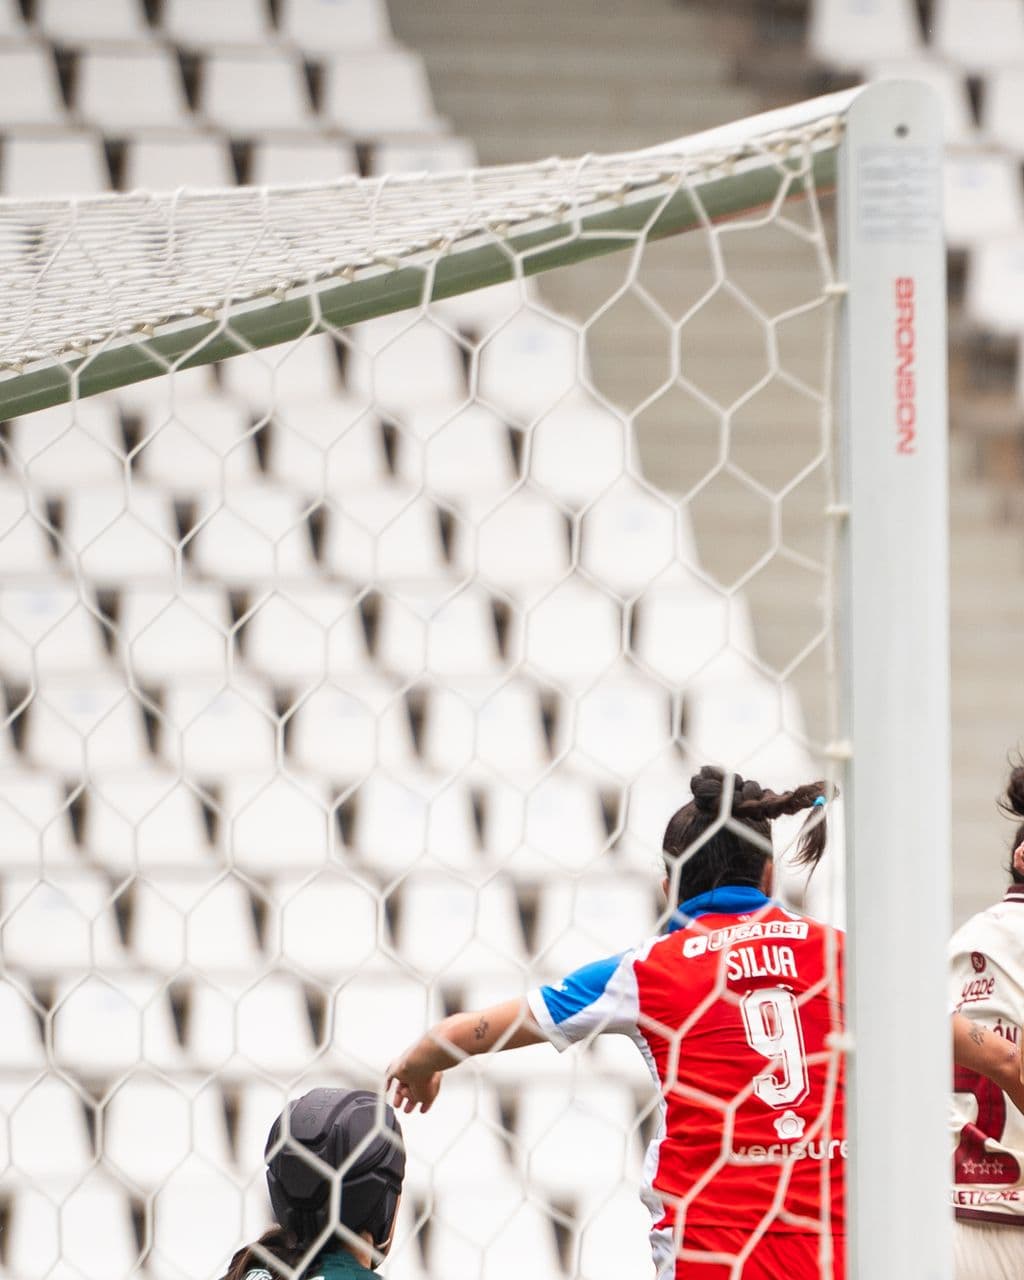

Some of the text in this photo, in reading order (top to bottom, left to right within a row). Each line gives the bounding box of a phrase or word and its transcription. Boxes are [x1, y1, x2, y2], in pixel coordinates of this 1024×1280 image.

[894, 276, 917, 455] BRONSON
[726, 945, 798, 981] SILVA
[739, 984, 810, 1110] 9
